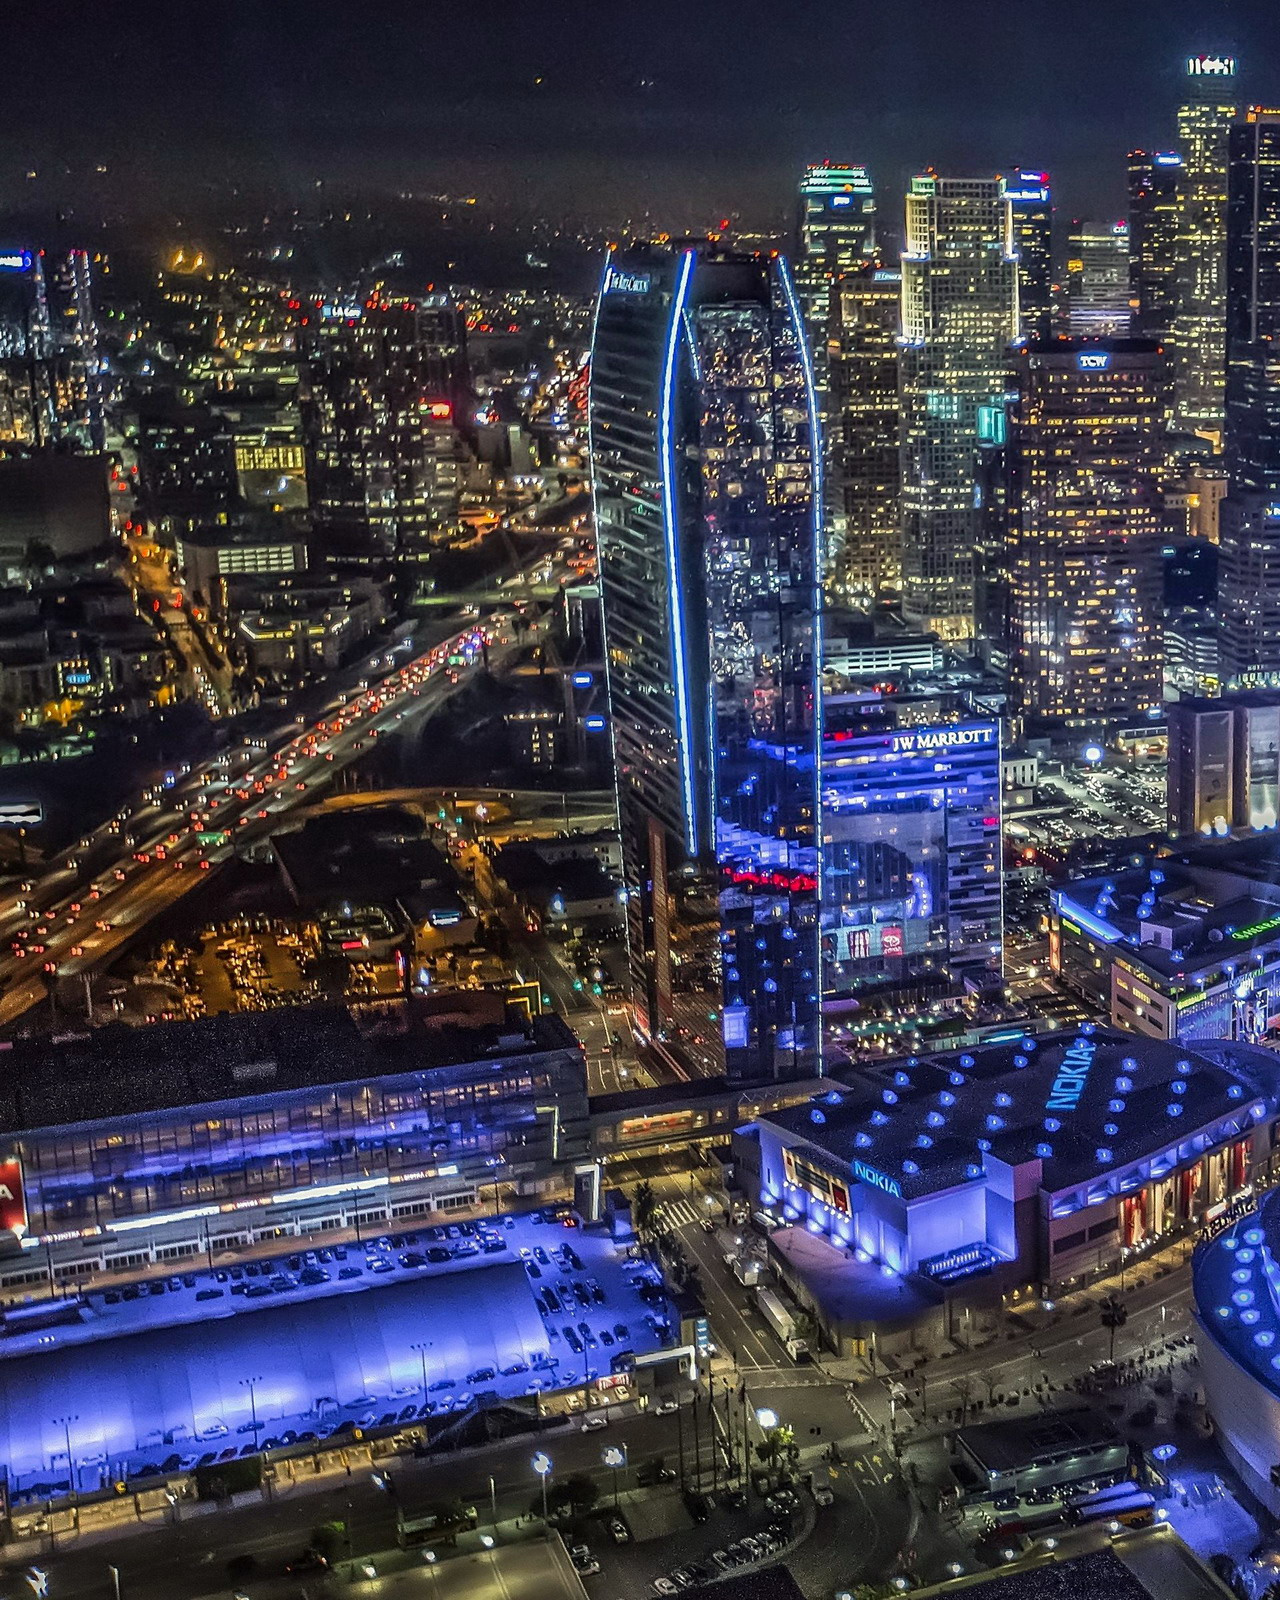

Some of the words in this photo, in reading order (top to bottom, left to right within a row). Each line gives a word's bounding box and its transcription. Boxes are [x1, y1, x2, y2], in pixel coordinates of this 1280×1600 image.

[1080, 355, 1108, 368] TCW
[893, 736, 915, 752] JW
[917, 728, 993, 749] MARRIOTT
[1046, 1046, 1096, 1109] NOKIA
[854, 1161, 900, 1198] NOKIA
